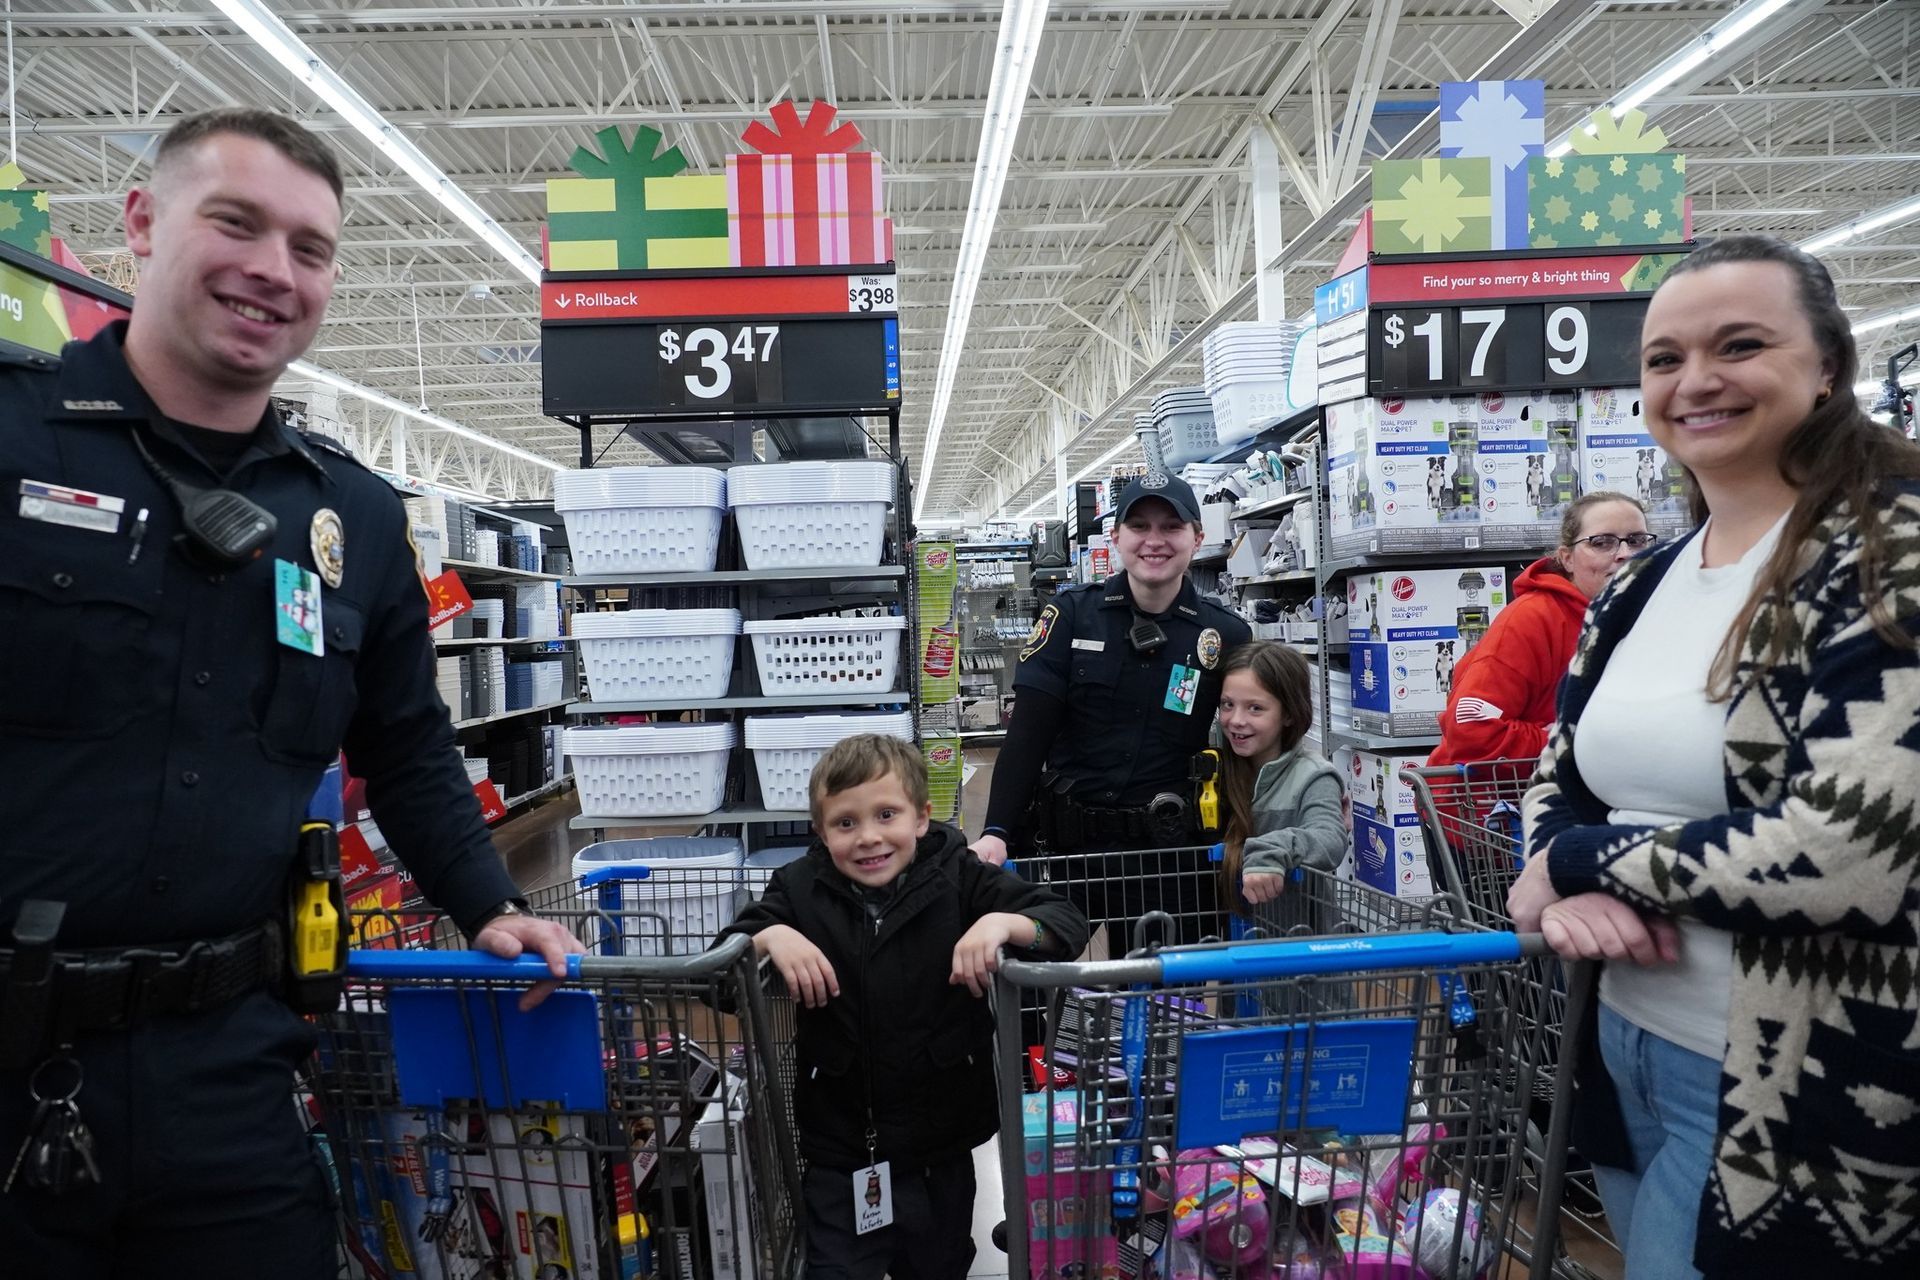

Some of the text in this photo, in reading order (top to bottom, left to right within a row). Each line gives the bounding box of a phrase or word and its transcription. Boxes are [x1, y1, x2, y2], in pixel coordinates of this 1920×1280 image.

[861, 276, 881, 285] Was:
[1423, 269, 1610, 290] Find your so merry & bright thing
[575, 292, 638, 308] Rollback
[1328, 283, 1355, 315] H 51
[429, 601, 465, 626] Rollback
[676, 1232, 694, 1280] FORTNIT
